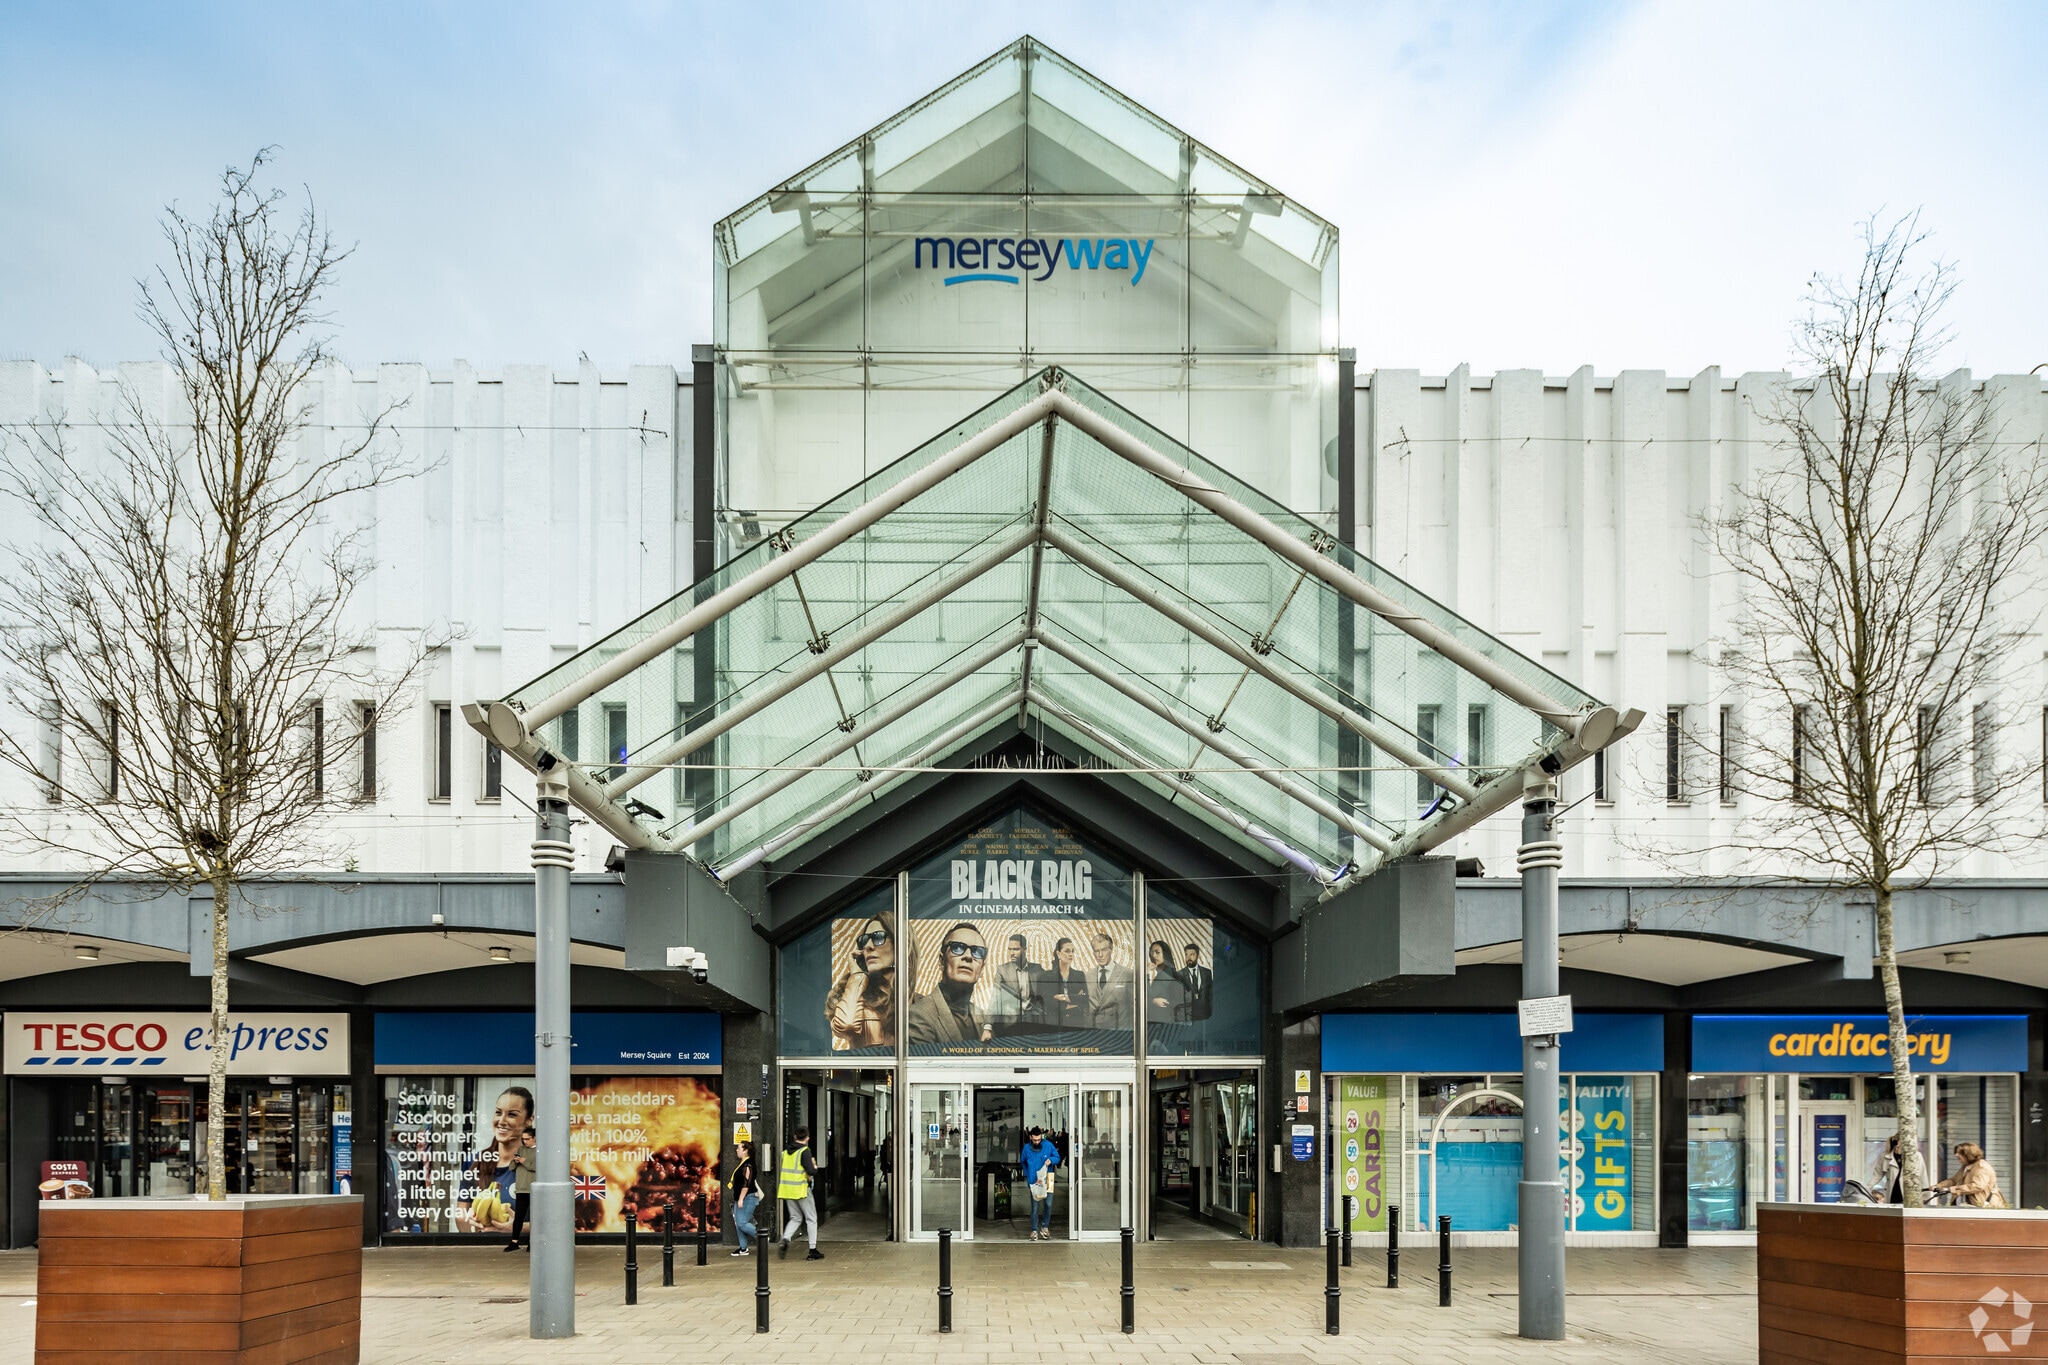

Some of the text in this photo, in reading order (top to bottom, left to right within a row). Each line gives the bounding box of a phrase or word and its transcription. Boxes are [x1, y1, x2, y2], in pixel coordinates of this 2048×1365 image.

[915, 237, 1154, 287] merseyway
[951, 859, 1092, 900] BLACK BAG
[959, 904, 1085, 914] IN CINEMAS MARCH 14
[23, 1023, 167, 1051] TESCO
[1769, 1023, 1951, 1064] cardfacory
[620, 1051, 710, 1060] Mersey Square Est 2024
[570, 1091, 676, 1105] Our cheddars
[1347, 1086, 1378, 1098] VALUE!
[1559, 1086, 1630, 1099] QALITY!
[398, 1091, 456, 1109] Serving
[398, 1110, 488, 1128] Stockport's
[570, 1110, 642, 1124] are made
[570, 1129, 648, 1143] with 100%
[397, 1147, 500, 1162] communities
[570, 1147, 656, 1162] British milk
[50, 1163, 78, 1171] COSTA
[1365, 1110, 1382, 1218] CARDS
[1594, 1110, 1626, 1219] GIFTS
[397, 1167, 480, 1185] and planet
[397, 1185, 500, 1199] a little better
[397, 1204, 474, 1221] every day
